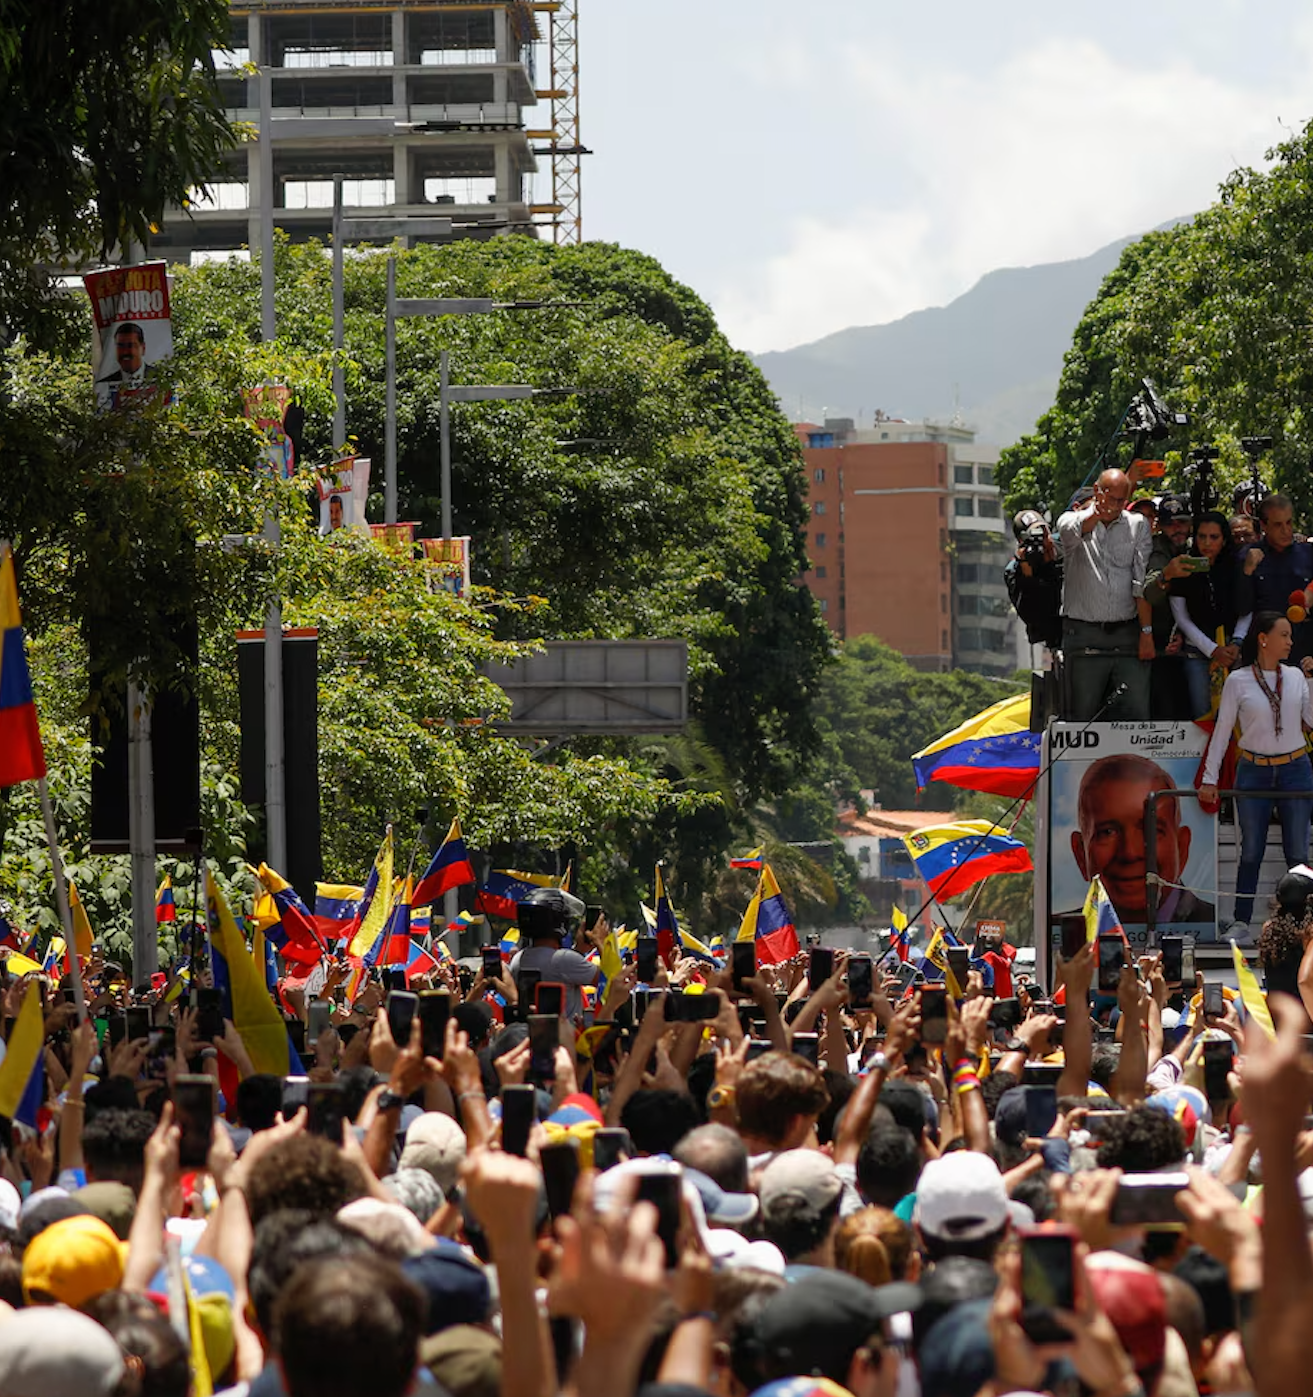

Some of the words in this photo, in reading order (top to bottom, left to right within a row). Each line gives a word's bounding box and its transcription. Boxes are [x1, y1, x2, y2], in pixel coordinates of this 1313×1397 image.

[98, 290, 164, 320] MDURO
[1110, 722, 1134, 730] Mesa
[1130, 735, 1174, 745] Unidad
